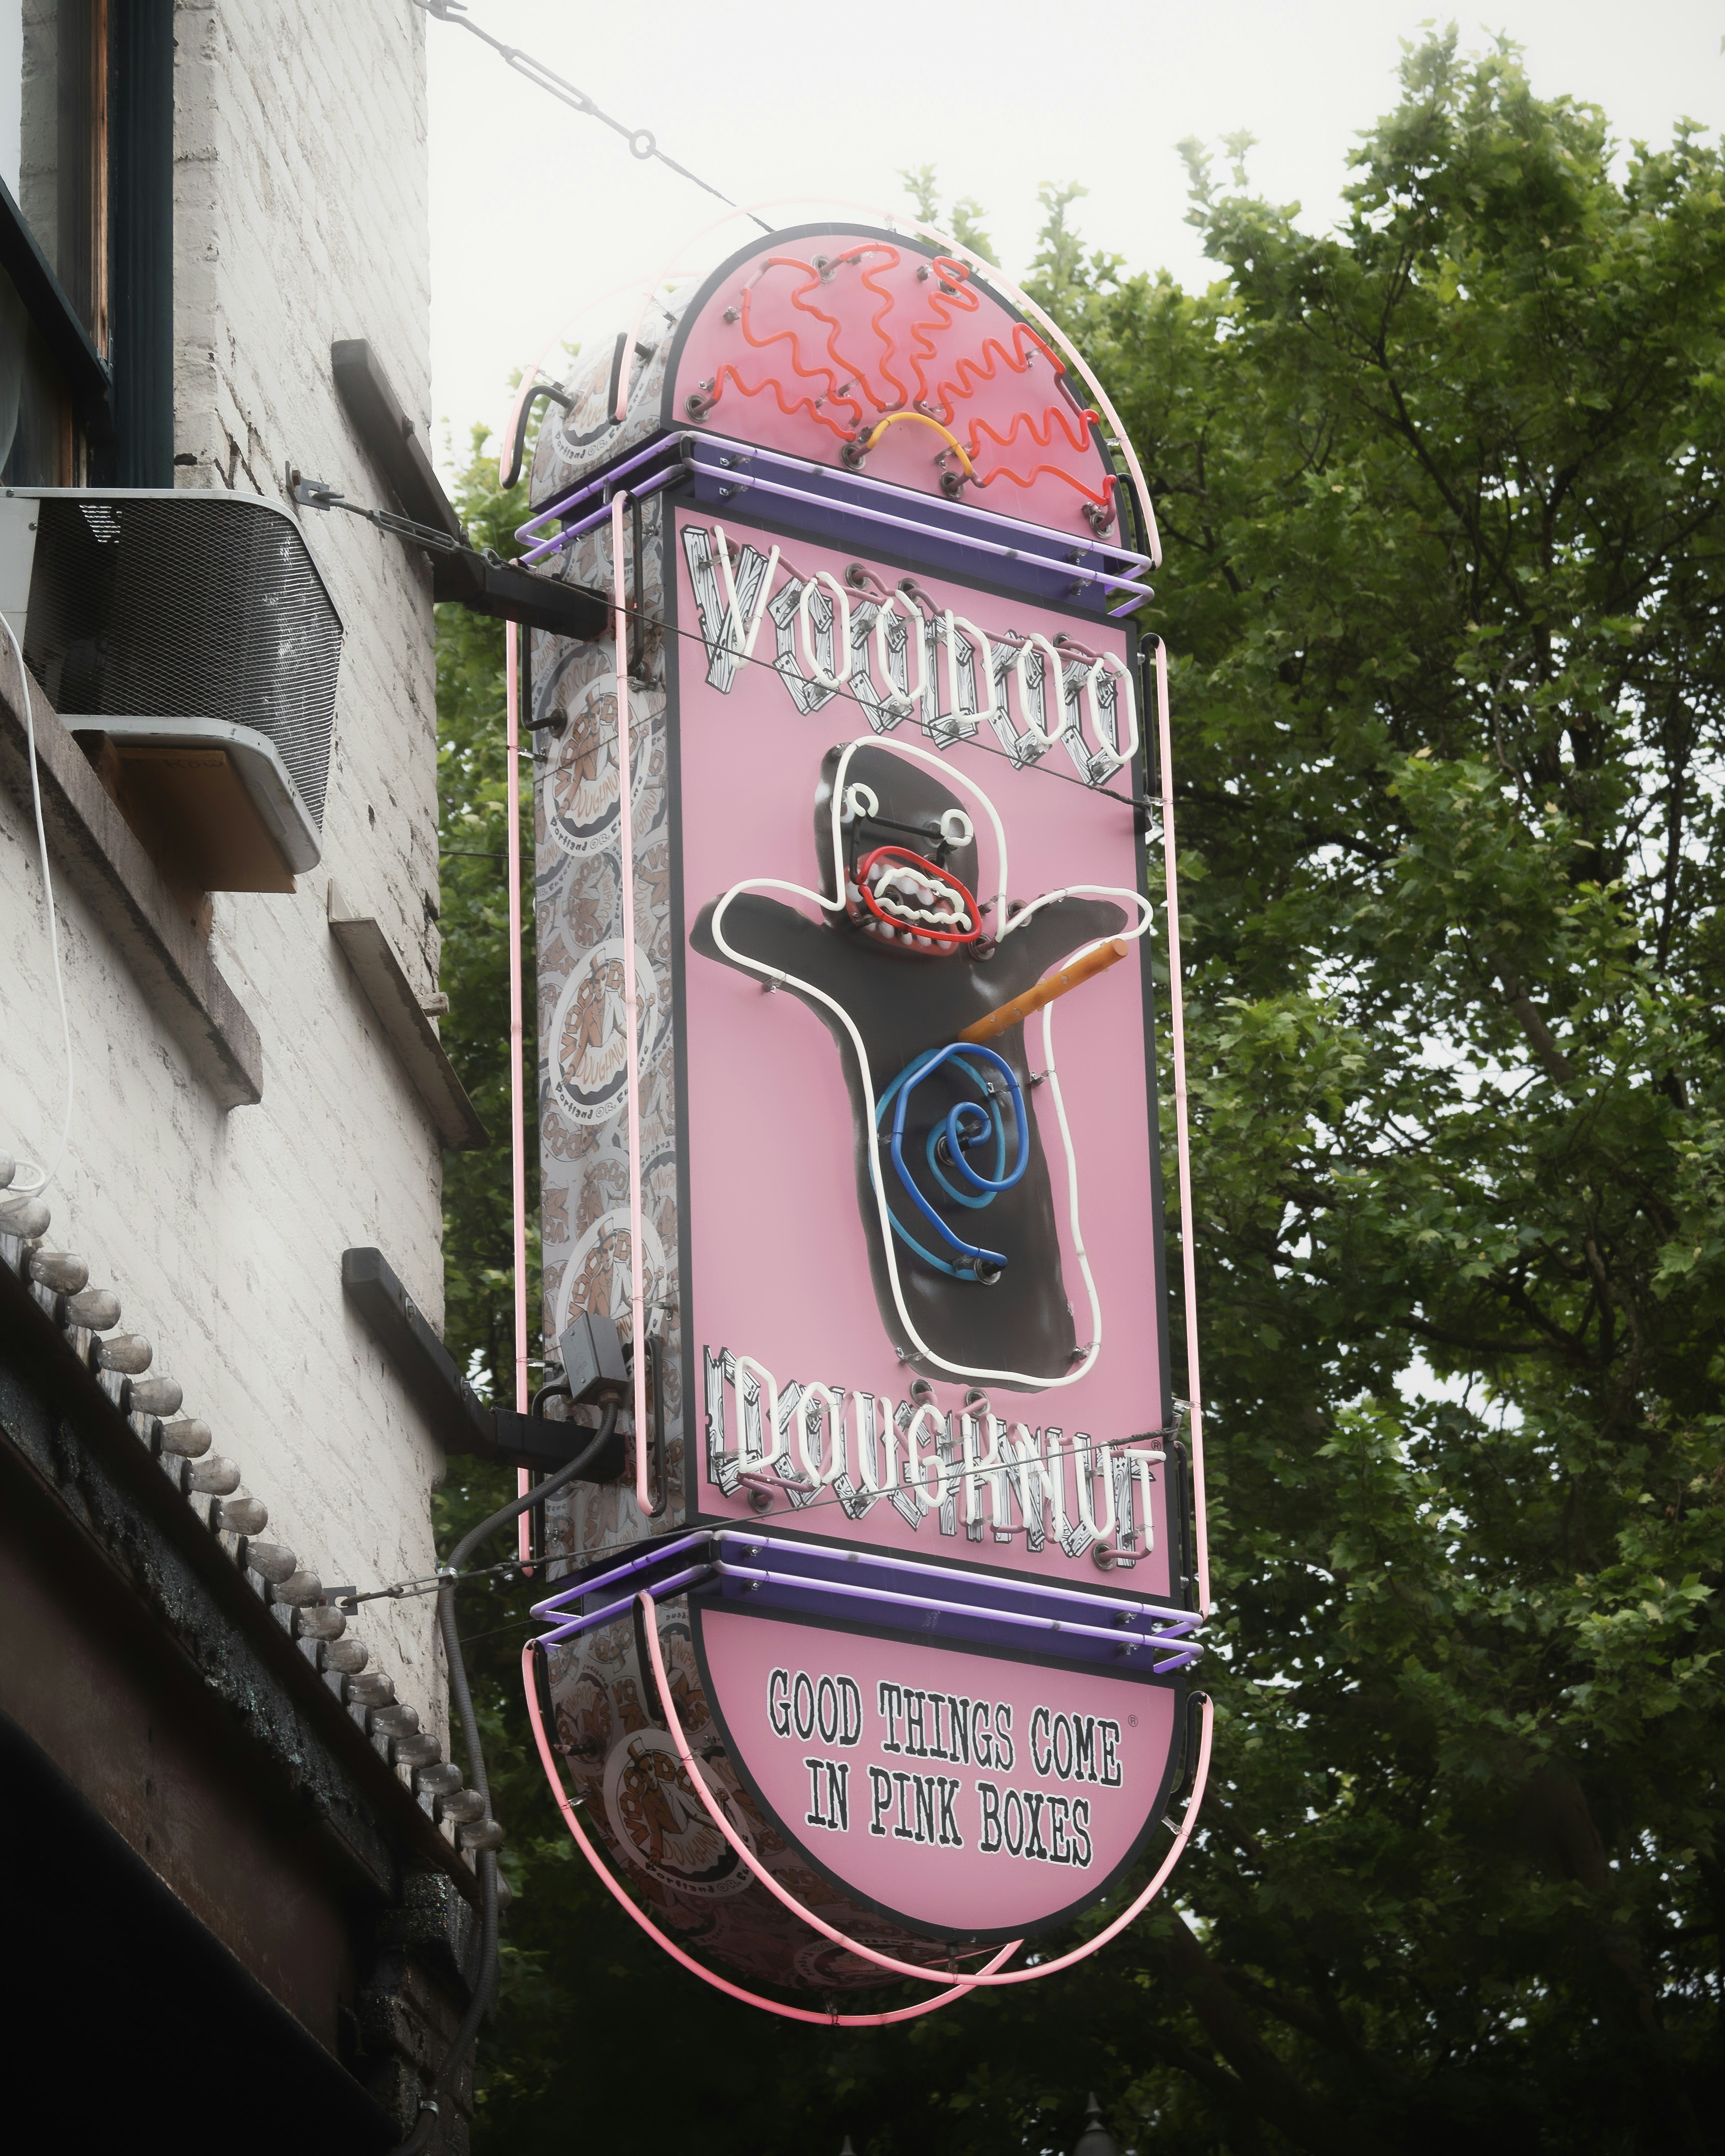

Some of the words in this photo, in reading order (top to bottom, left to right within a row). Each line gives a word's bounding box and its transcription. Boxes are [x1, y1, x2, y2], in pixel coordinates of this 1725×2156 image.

[680, 524, 1139, 786] VOODOO
[550, 816, 587, 851] Portland
[556, 1081, 593, 1119] Portland
[703, 1345, 1165, 1568] DOUGHNUT
[767, 1666, 863, 1747] GOOD
[877, 1679, 1015, 1773] THINGS
[1029, 1705, 1123, 1788] COME
[803, 1756, 850, 1833] IN
[866, 1763, 964, 1849] PINK
[976, 1781, 1093, 1870] BOXES
[645, 1862, 715, 1893] Portland
